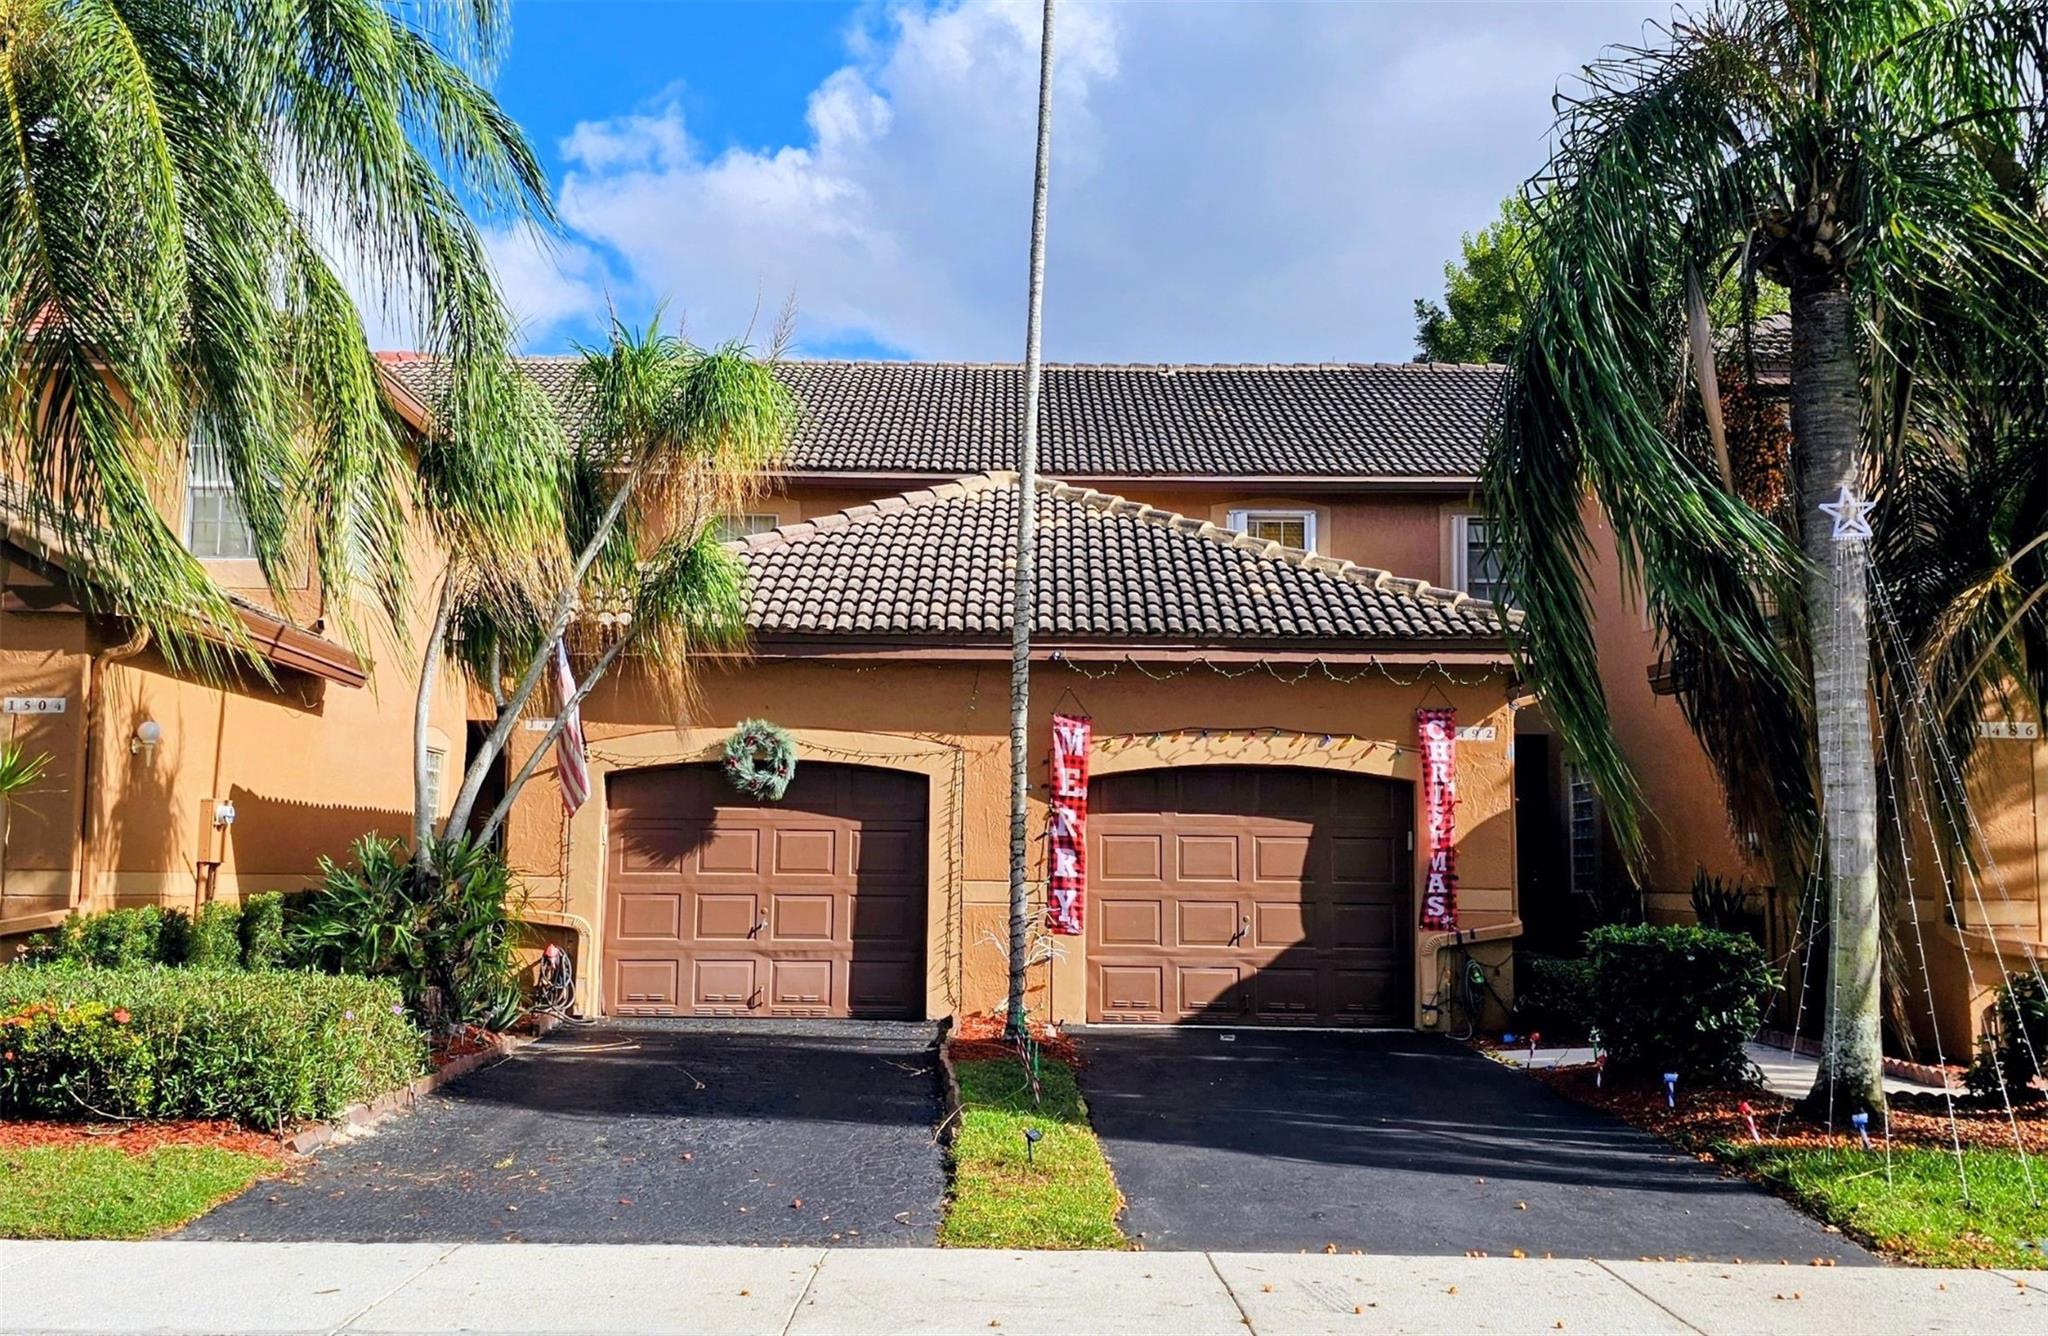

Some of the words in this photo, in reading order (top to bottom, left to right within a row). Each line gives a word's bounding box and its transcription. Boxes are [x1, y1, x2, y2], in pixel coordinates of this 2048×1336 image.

[7, 700, 62, 711] 1504
[1456, 729, 1493, 739] 492
[1054, 726, 1086, 922] MERRY
